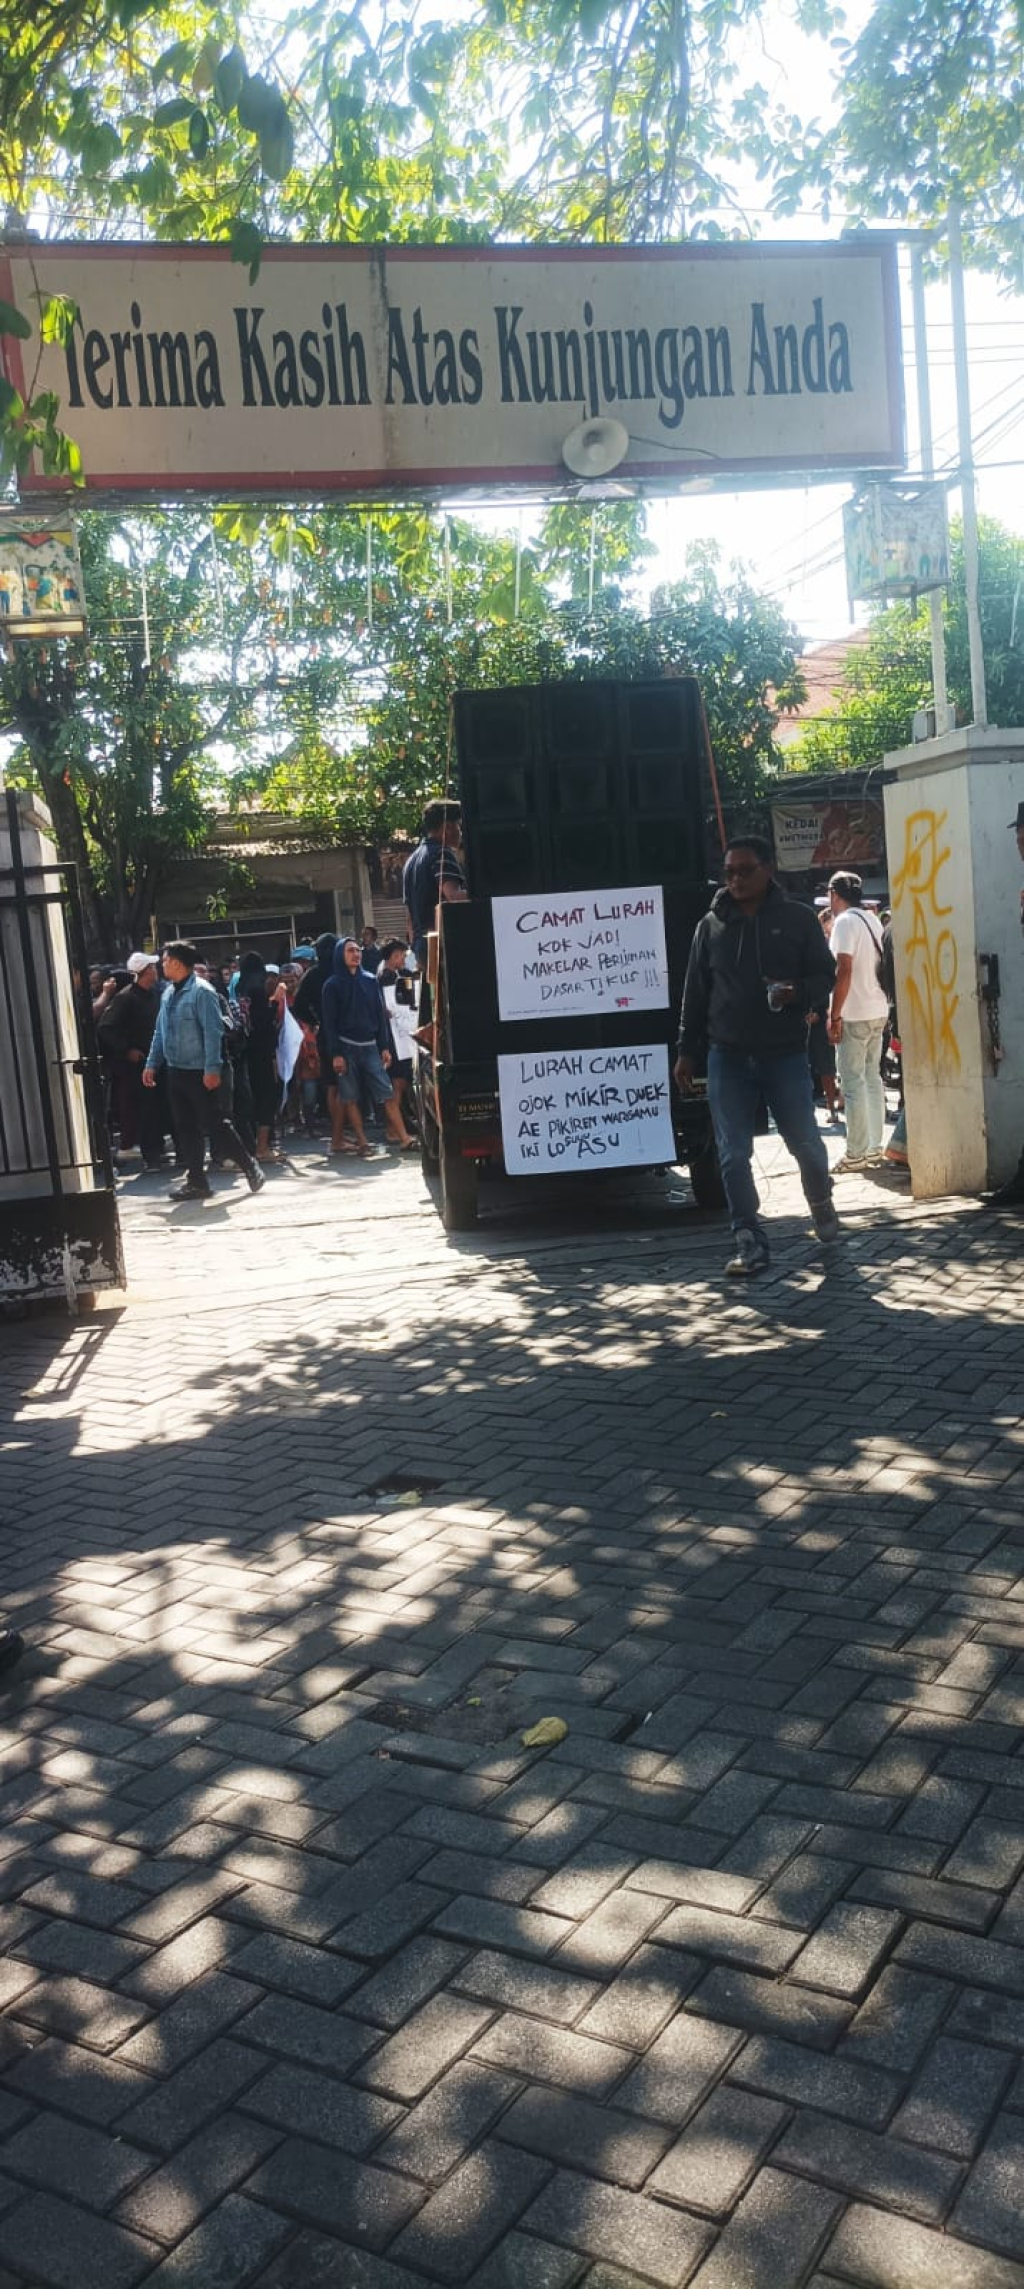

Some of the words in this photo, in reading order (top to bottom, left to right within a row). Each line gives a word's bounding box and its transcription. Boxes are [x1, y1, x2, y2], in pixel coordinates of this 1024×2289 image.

[65, 301, 226, 409] Terima
[233, 302, 372, 408] Kasih
[385, 306, 484, 406] Atas
[494, 301, 734, 429] Kunjungan
[745, 297, 853, 396] Anda
[516, 907, 585, 933] CAMAT
[593, 899, 655, 921] LURAH
[523, 956, 592, 980] MAKELAR
[540, 982, 584, 1001] DASAR
[520, 1055, 583, 1084] LURAH
[589, 1053, 653, 1074] CAMAT
[517, 1120, 540, 1138] AE
[576, 1132, 620, 1159] ASU
